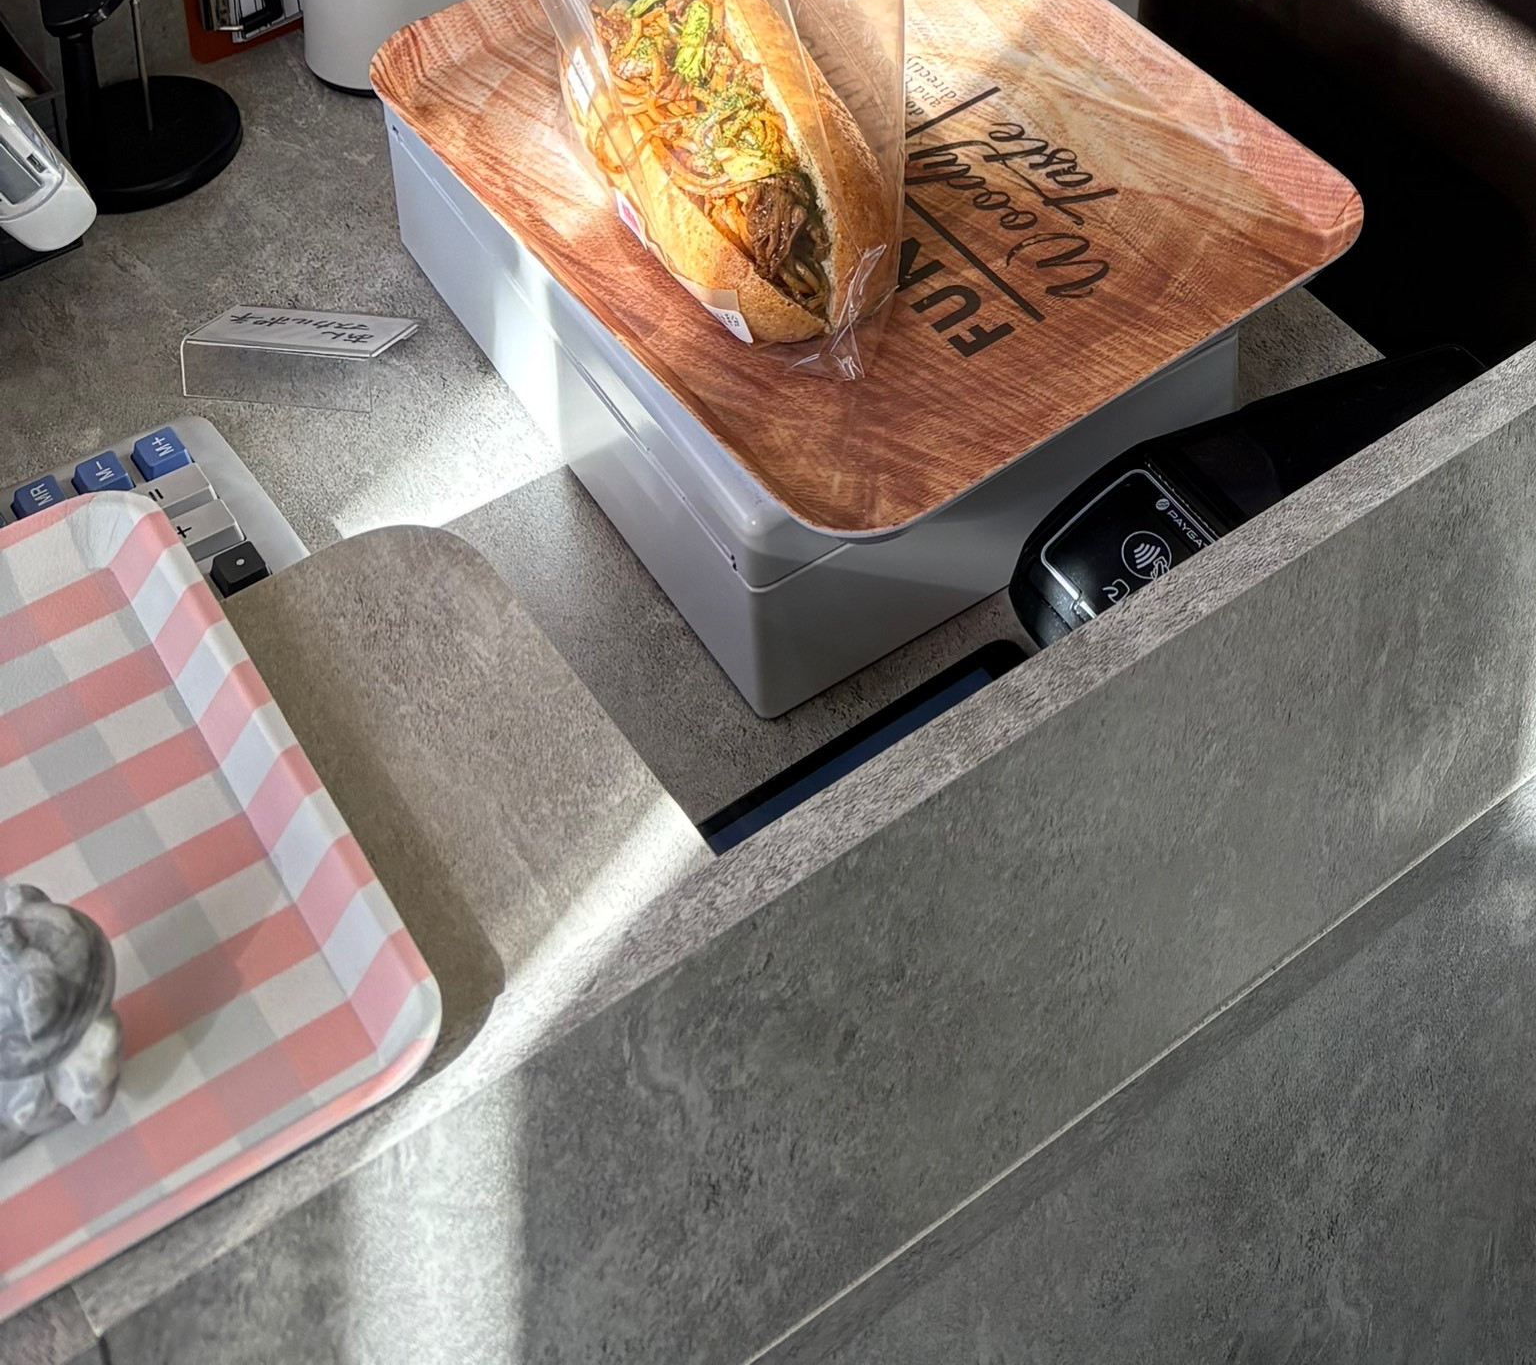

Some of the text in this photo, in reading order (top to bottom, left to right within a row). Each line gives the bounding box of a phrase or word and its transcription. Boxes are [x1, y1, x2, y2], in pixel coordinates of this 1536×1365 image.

[982, 122, 1119, 226] Taste
[904, 140, 1110, 299] Woody
[151, 436, 175, 458] M+
[29, 483, 54, 507] MR
